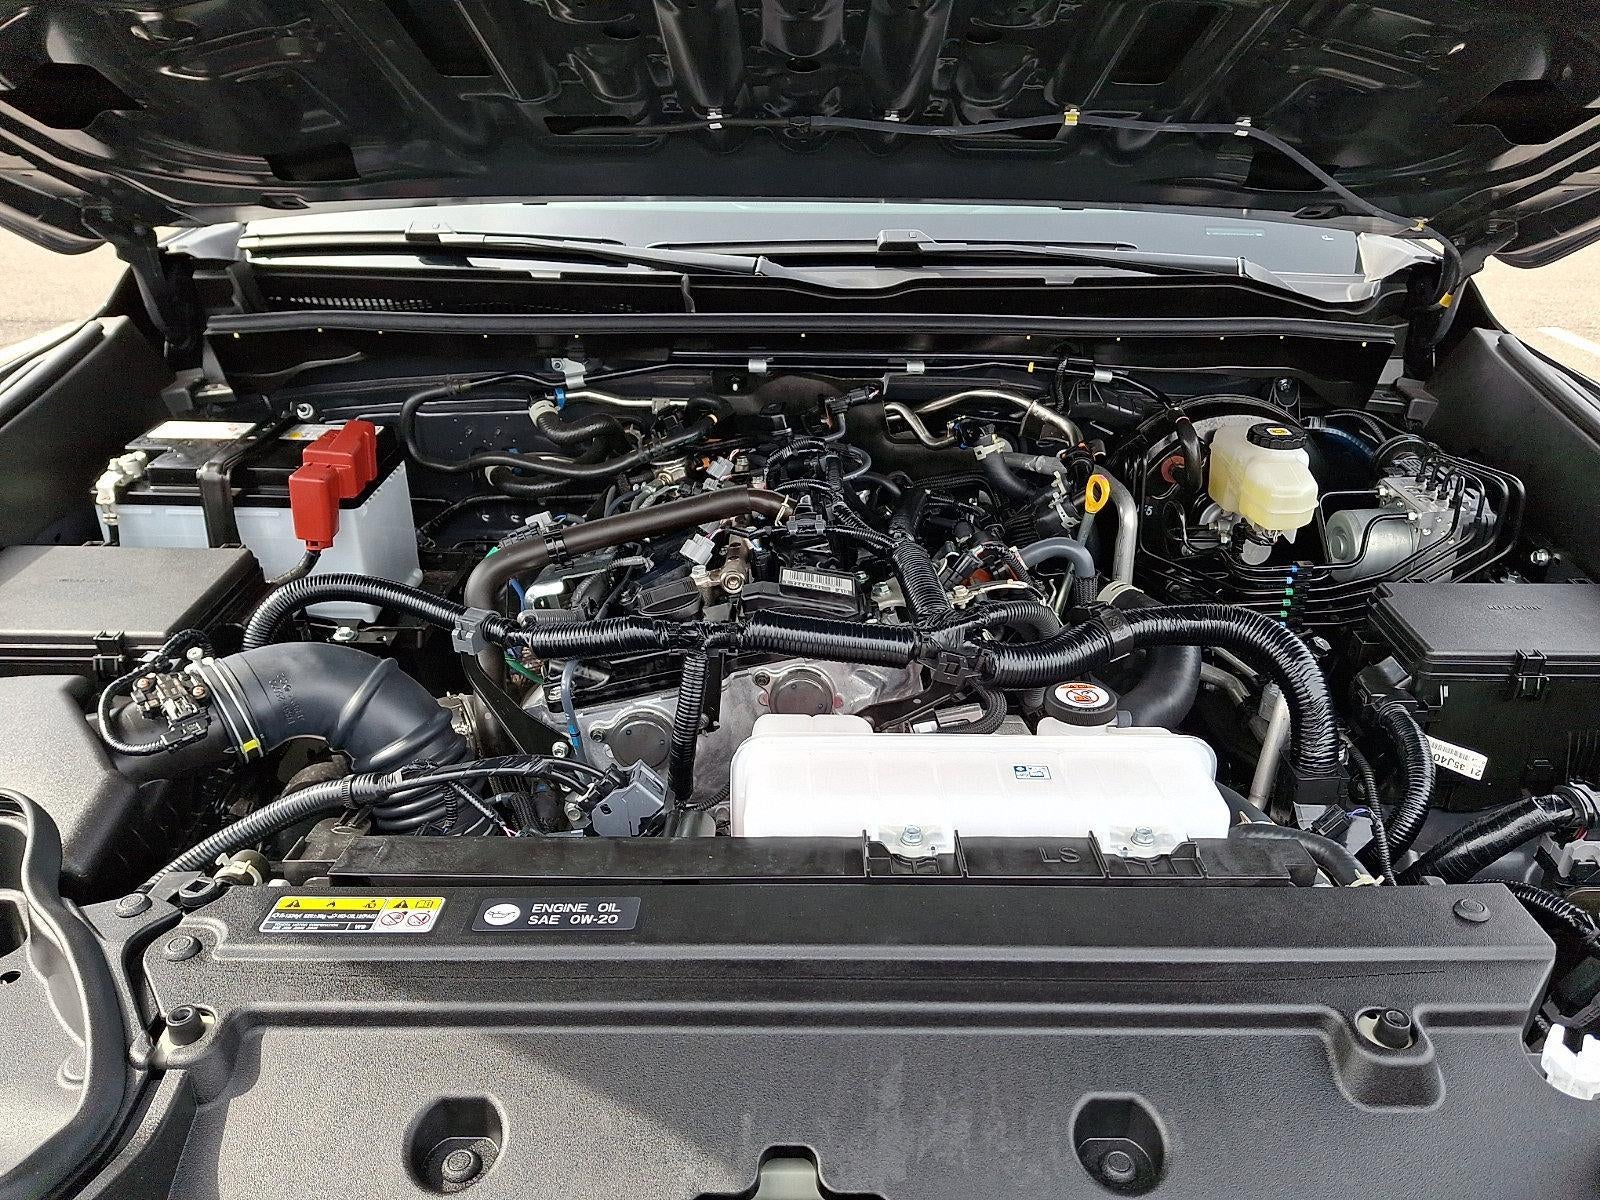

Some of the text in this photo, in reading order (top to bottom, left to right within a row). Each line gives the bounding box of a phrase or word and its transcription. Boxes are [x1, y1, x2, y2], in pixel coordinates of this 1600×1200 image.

[1038, 846, 1081, 863] LS
[531, 902, 622, 913] ENGINE OIL
[527, 914, 619, 925] SAE 0W-20
